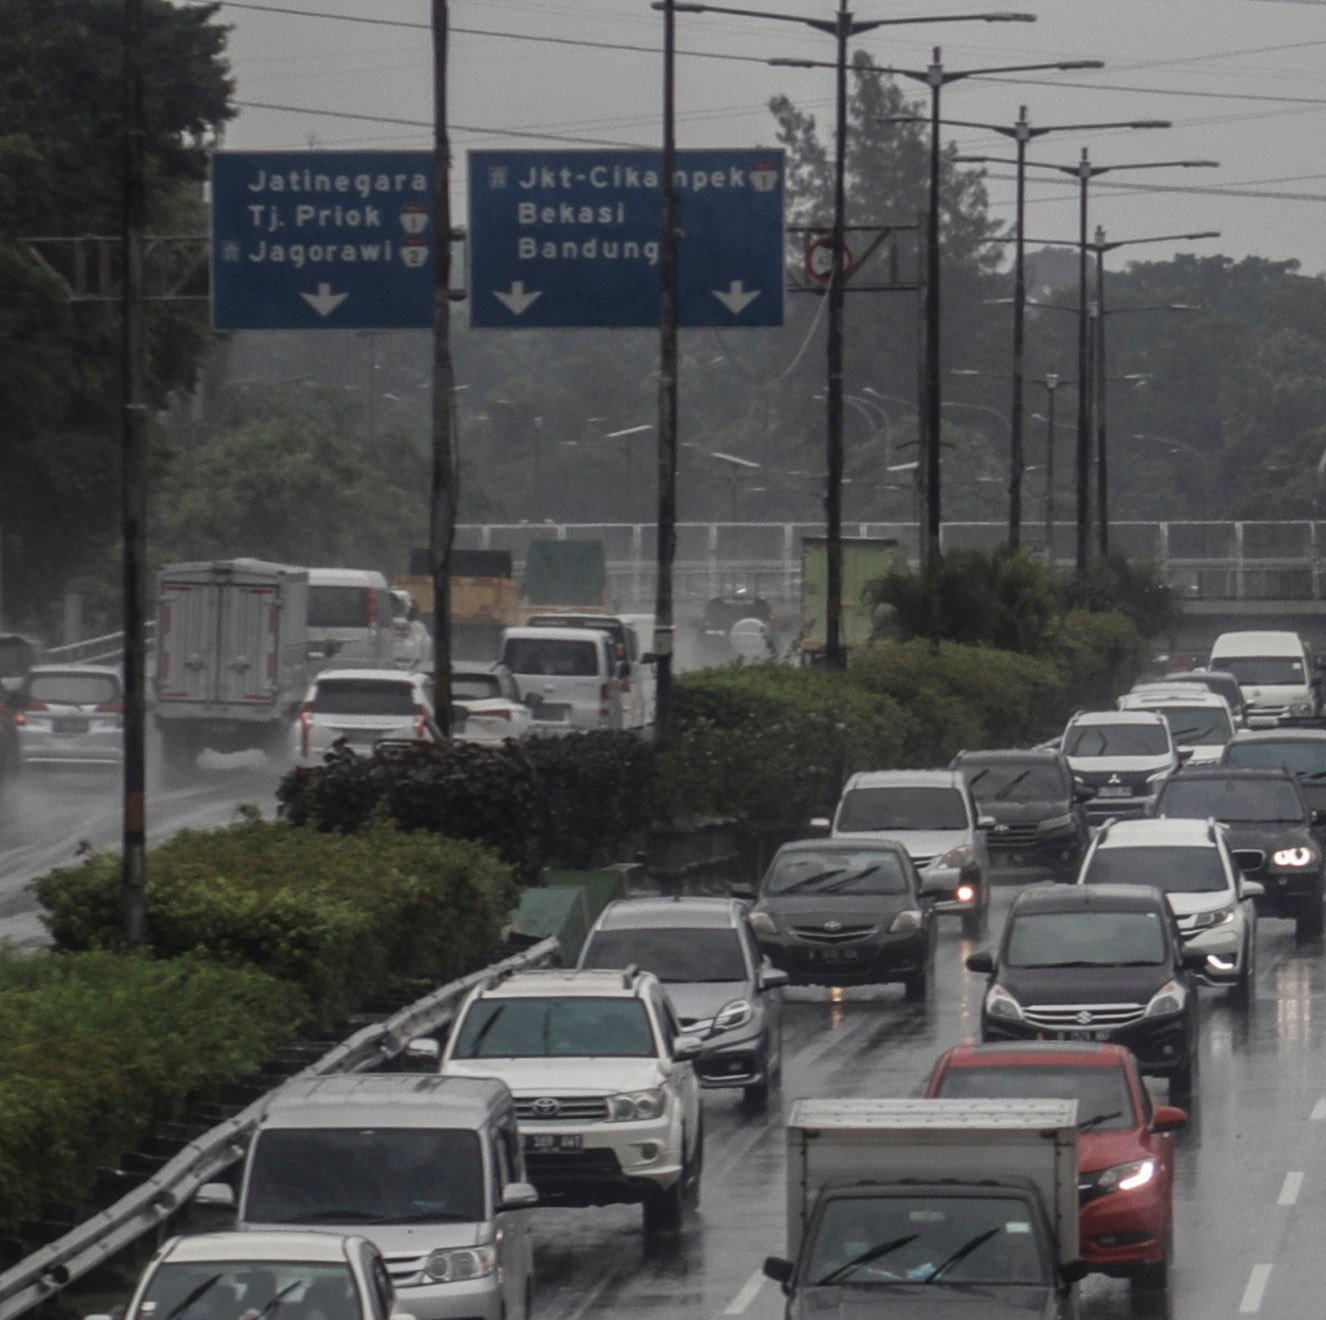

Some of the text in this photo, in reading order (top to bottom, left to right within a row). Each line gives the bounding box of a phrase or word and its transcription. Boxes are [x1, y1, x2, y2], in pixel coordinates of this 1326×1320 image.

[247, 169, 428, 199] Jatinegara
[247, 204, 381, 232] Tj. Priok
[518, 202, 625, 224] Bekasi
[248, 240, 393, 269] Jagorawi
[518, 237, 660, 265] Bandung
